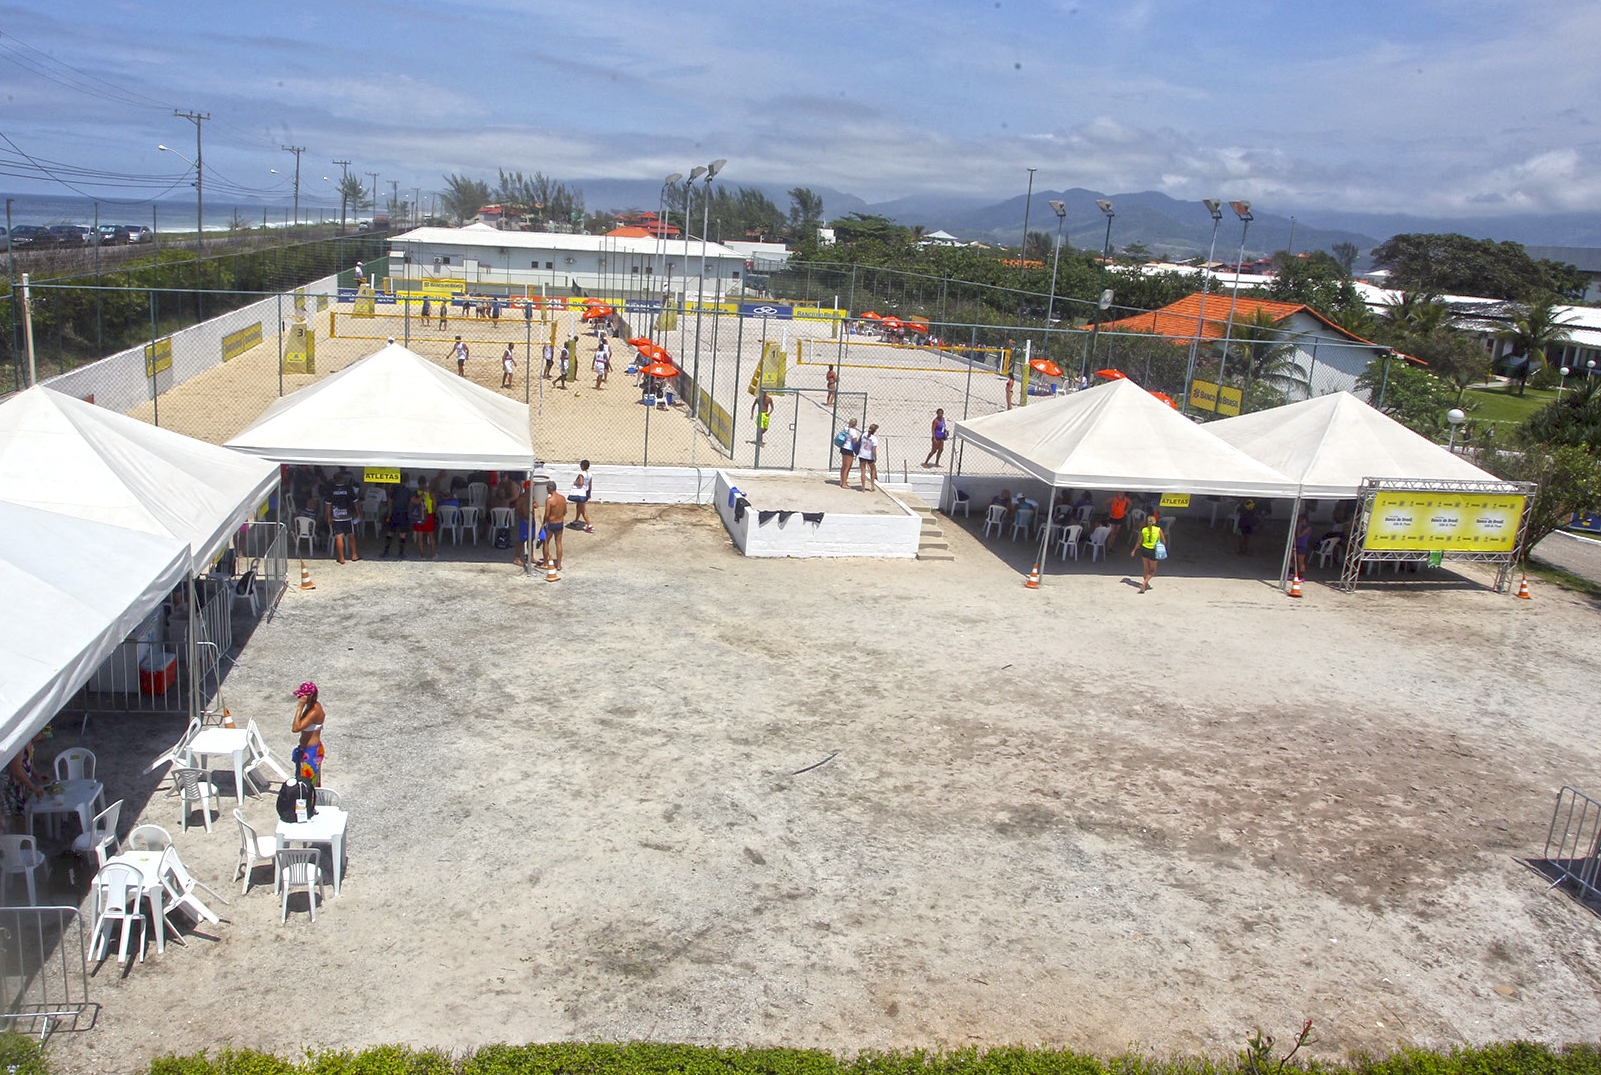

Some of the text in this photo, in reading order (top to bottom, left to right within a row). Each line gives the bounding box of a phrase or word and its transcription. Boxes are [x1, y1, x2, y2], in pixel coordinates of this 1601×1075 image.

[297, 328, 303, 337] 3
[772, 350, 776, 358] 1
[1200, 391, 1216, 402] BANCO
[1223, 396, 1239, 408] BRASIL
